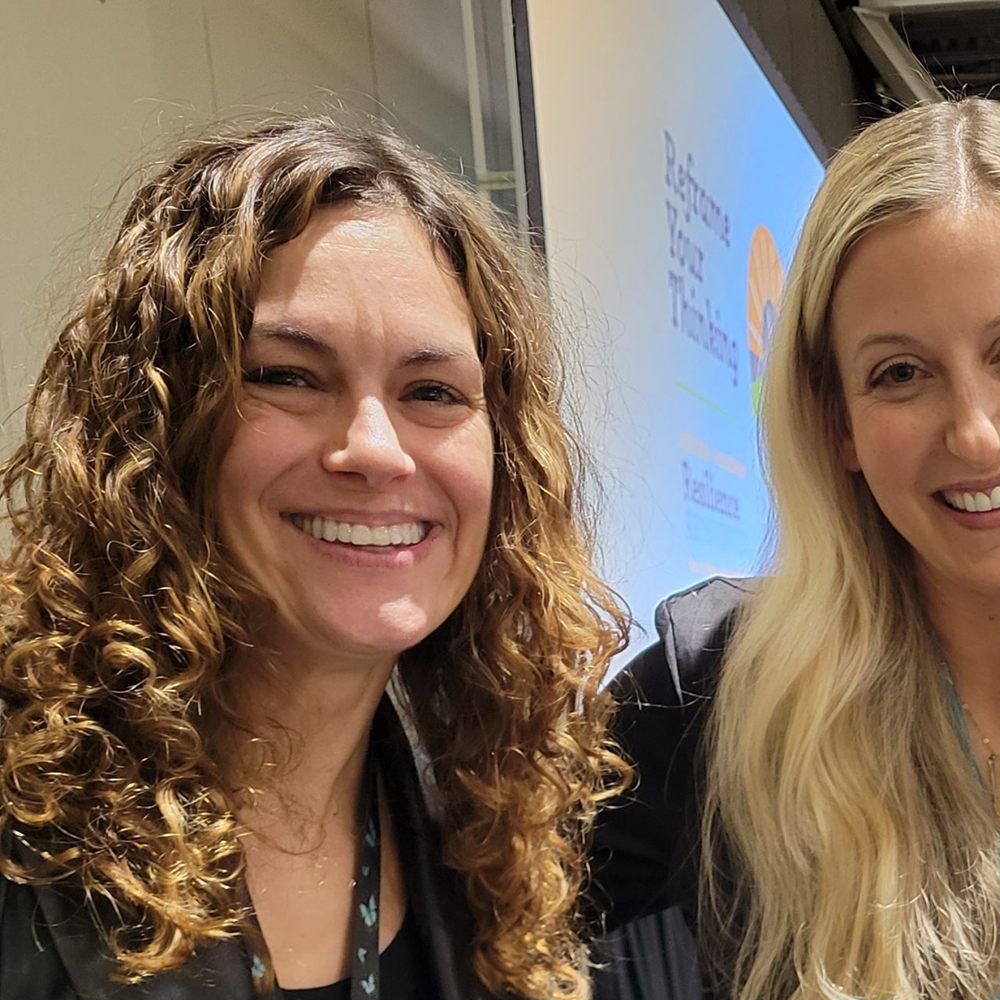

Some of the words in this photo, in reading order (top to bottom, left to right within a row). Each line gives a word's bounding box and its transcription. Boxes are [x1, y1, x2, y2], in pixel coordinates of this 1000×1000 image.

[664, 129, 730, 247] Reframe
[666, 200, 703, 282] Your
[668, 270, 738, 387] Thinking
